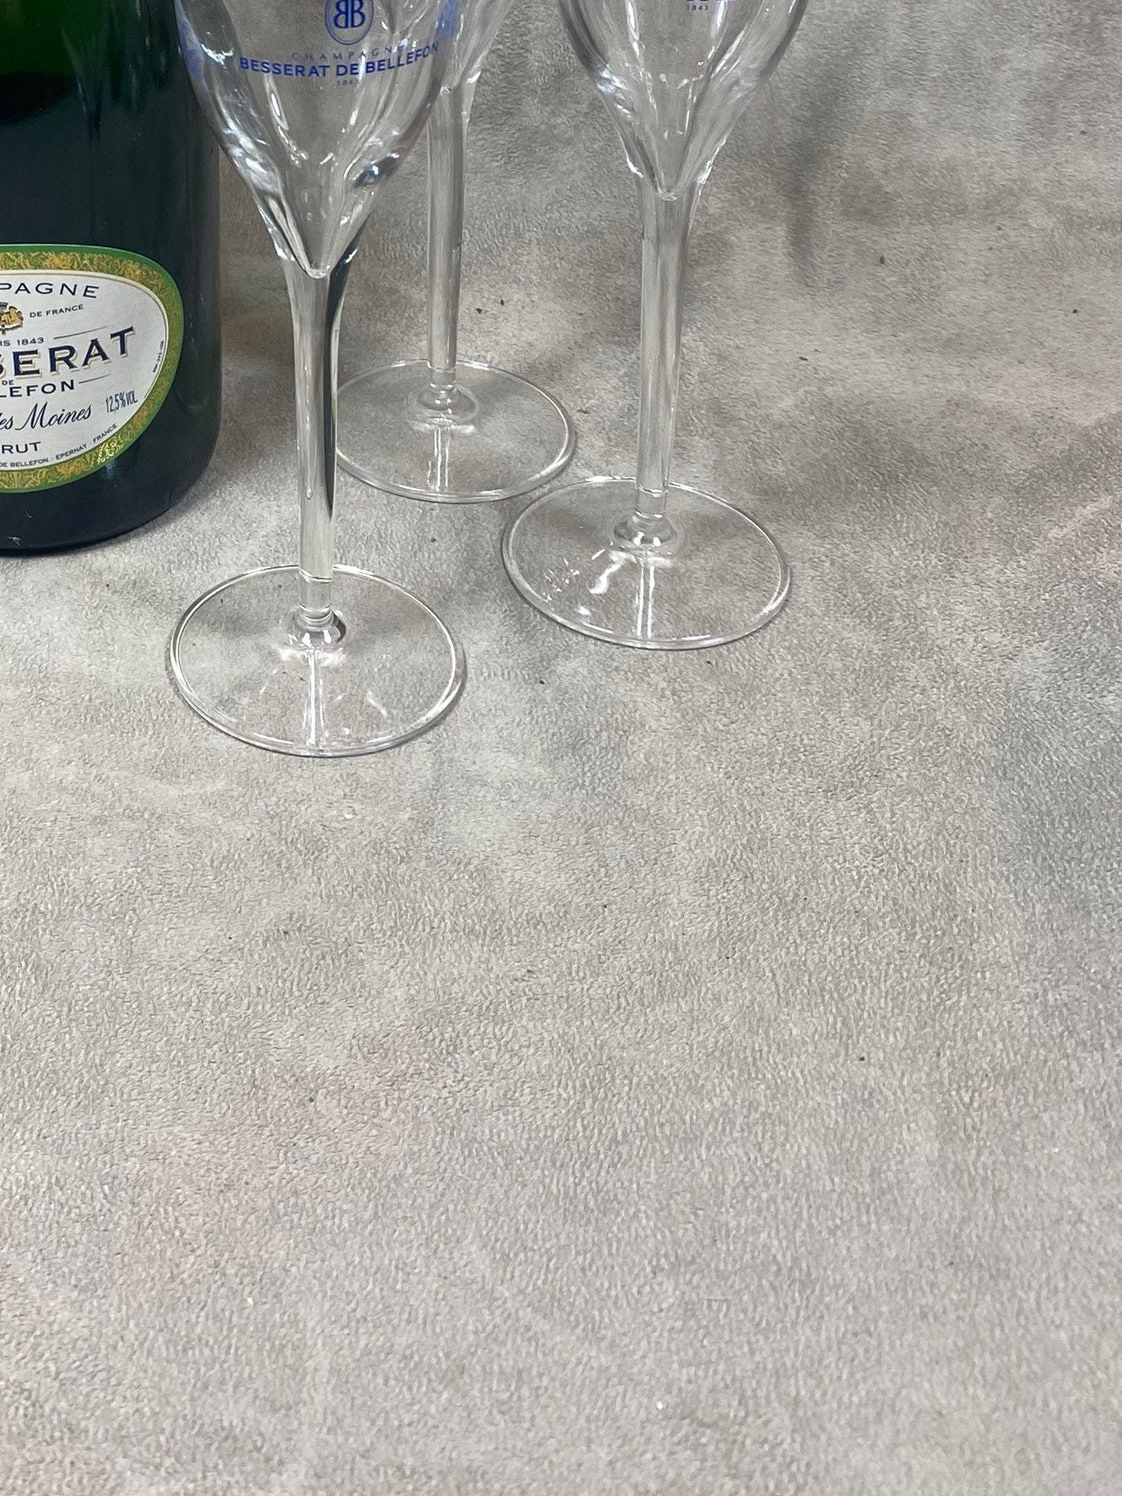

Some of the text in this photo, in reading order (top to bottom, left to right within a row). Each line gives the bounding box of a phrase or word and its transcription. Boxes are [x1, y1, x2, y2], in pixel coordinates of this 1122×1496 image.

[239, 42, 439, 77] BESSERAT DE BELLEFON
[46, 304, 84, 316] FRANCE
[17, 337, 44, 346] 1843
[14, 402, 92, 430] Moines
[10, 458, 49, 468] BELLEFON
[93, 423, 118, 444] FRANCE
